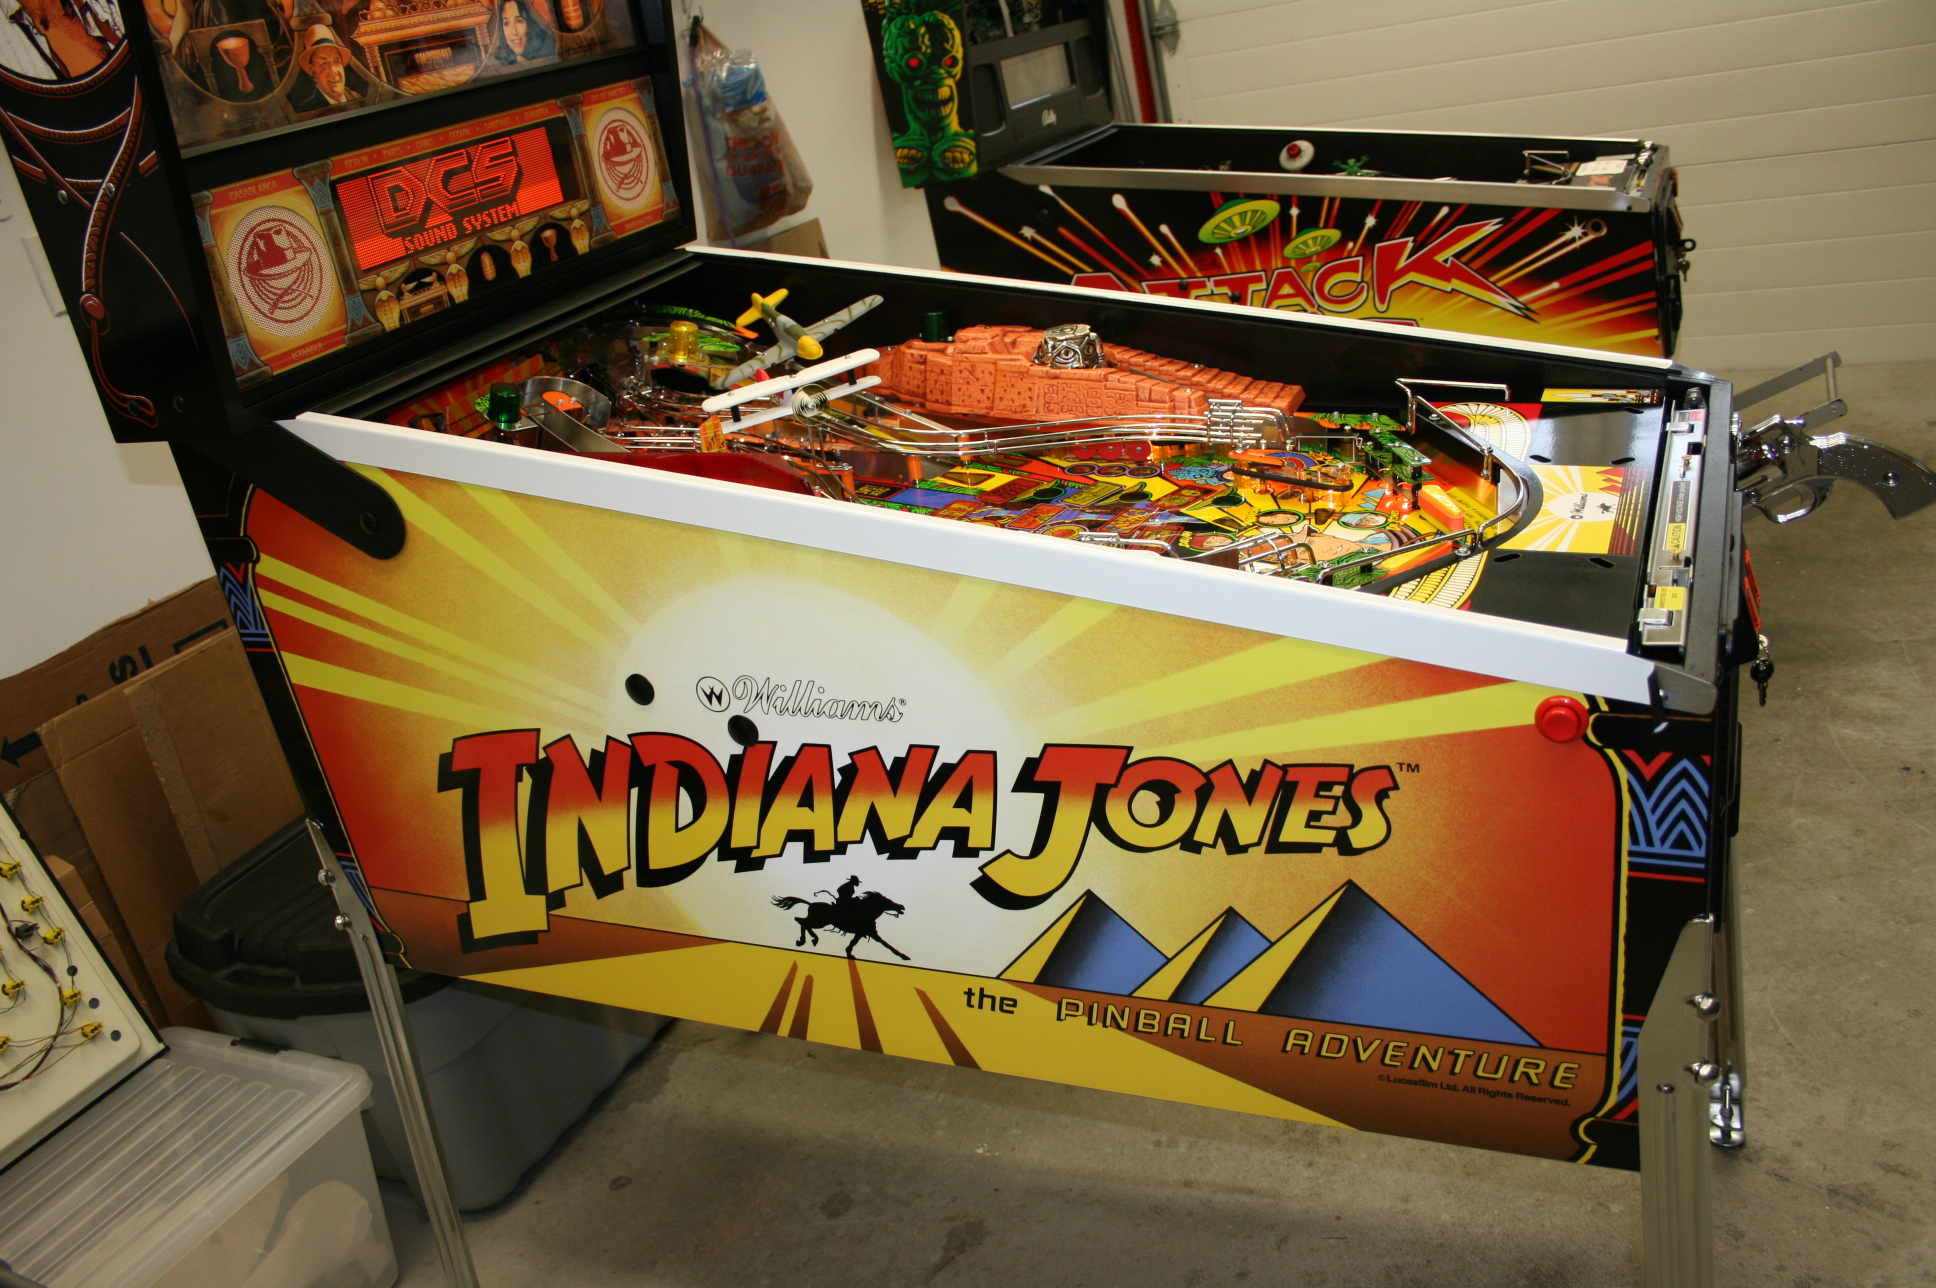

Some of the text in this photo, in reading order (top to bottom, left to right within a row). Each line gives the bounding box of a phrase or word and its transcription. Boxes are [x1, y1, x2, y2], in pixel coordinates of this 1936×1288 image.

[344, 155, 369, 168] BERLIN
[383, 146, 402, 158] PARIS
[416, 137, 434, 148] CAIRO
[229, 180, 278, 201] CASABLANCA
[403, 201, 521, 254] SOUND SYSTEM
[1071, 217, 1540, 324] TACK
[1670, 525, 1682, 545] CAUTION
[438, 727, 998, 954] INDIANA
[970, 743, 1399, 910] JONES
[963, 986, 1580, 1090] the PINBALL ADVENTURE
[1440, 1081, 1460, 1092] Ltd.
[1462, 1085, 1476, 1095] All
[1478, 1087, 1514, 1100] Rights
[1515, 1091, 1571, 1107] Reserved.
